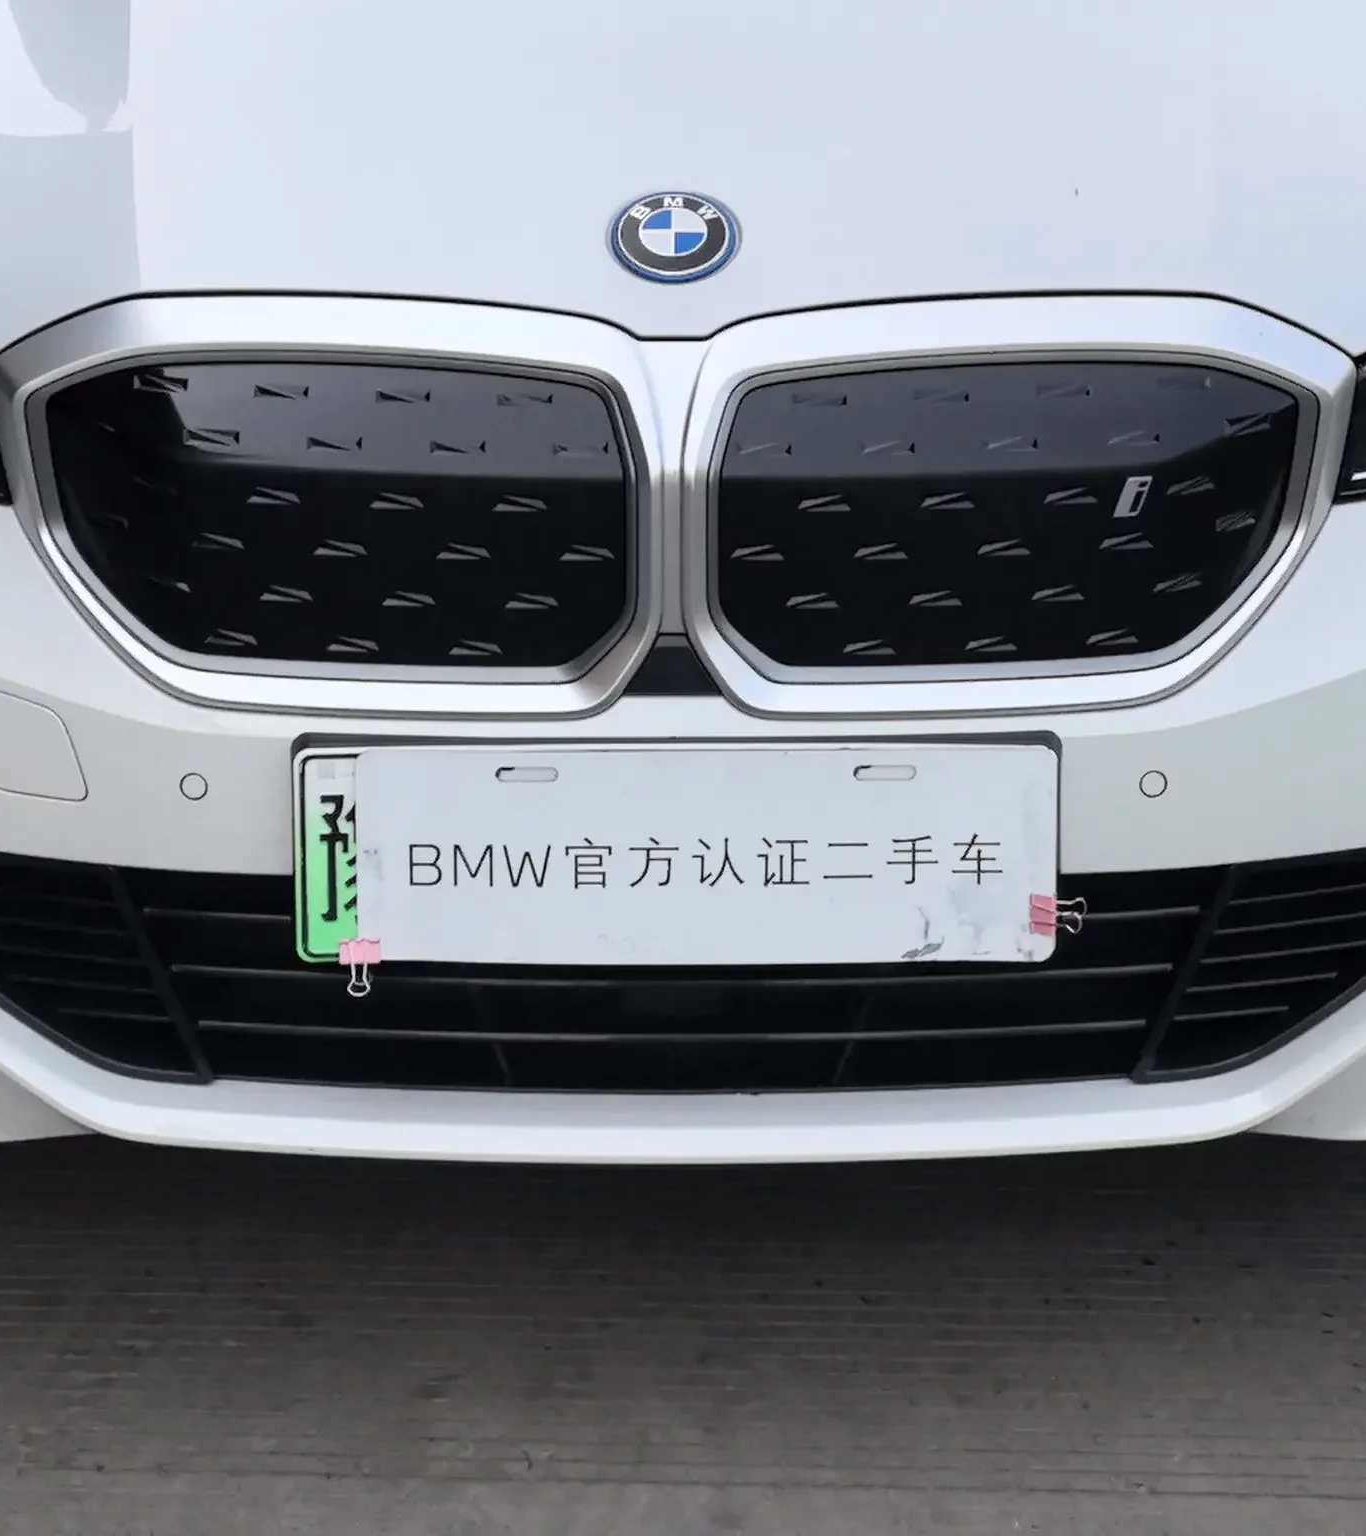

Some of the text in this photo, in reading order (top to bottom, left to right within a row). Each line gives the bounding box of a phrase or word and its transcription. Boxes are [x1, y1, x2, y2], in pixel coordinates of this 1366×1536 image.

[629, 195, 720, 221] BMW
[407, 832, 1004, 890] BMW官方认证二手车
